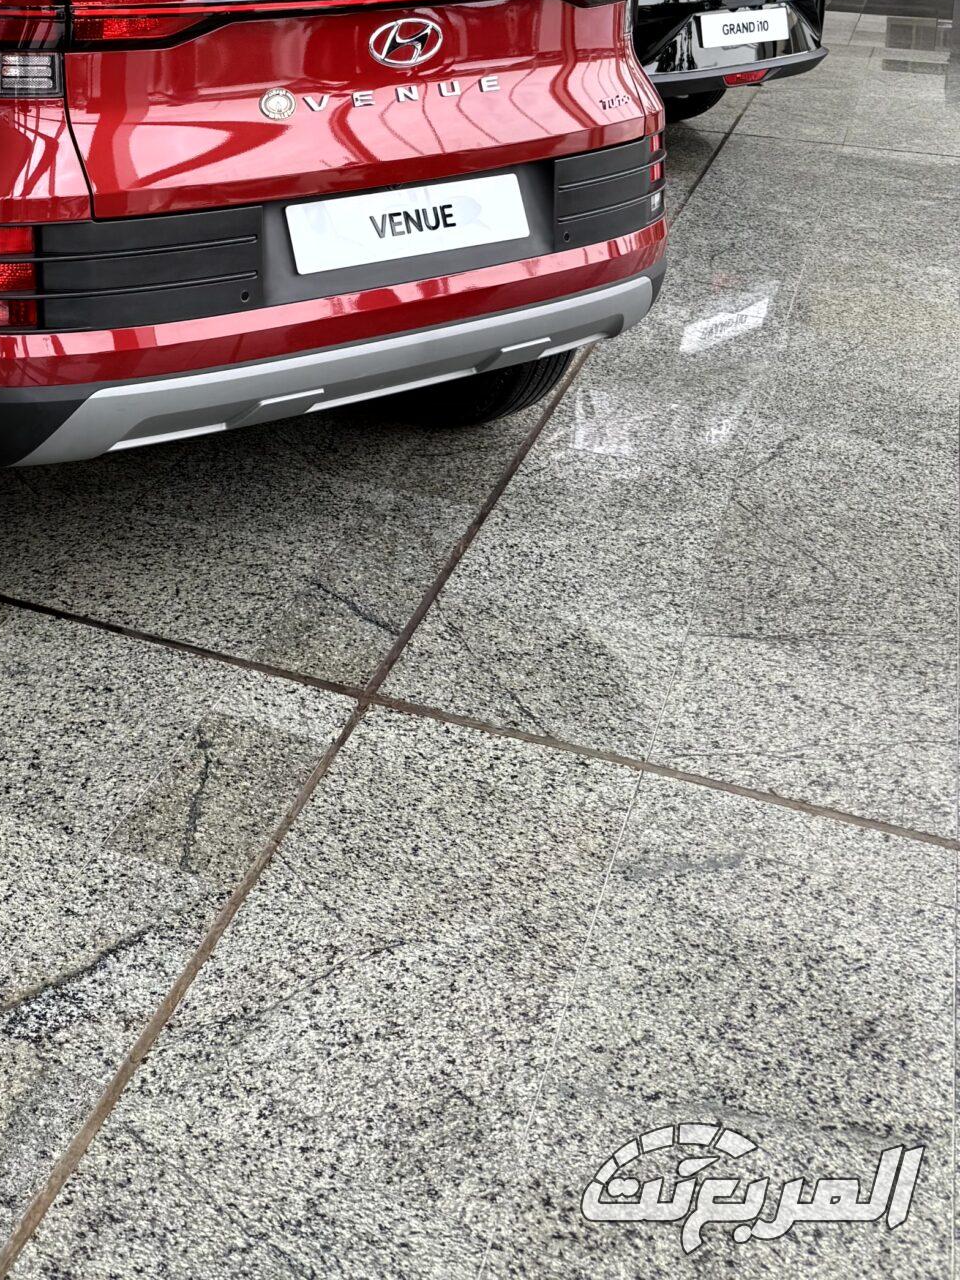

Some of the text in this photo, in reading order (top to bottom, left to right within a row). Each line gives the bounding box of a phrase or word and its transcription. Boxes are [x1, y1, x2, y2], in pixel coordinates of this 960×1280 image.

[722, 20, 769, 35] GRAND i10
[303, 76, 501, 111] VENUE
[369, 204, 456, 239] VENUE
